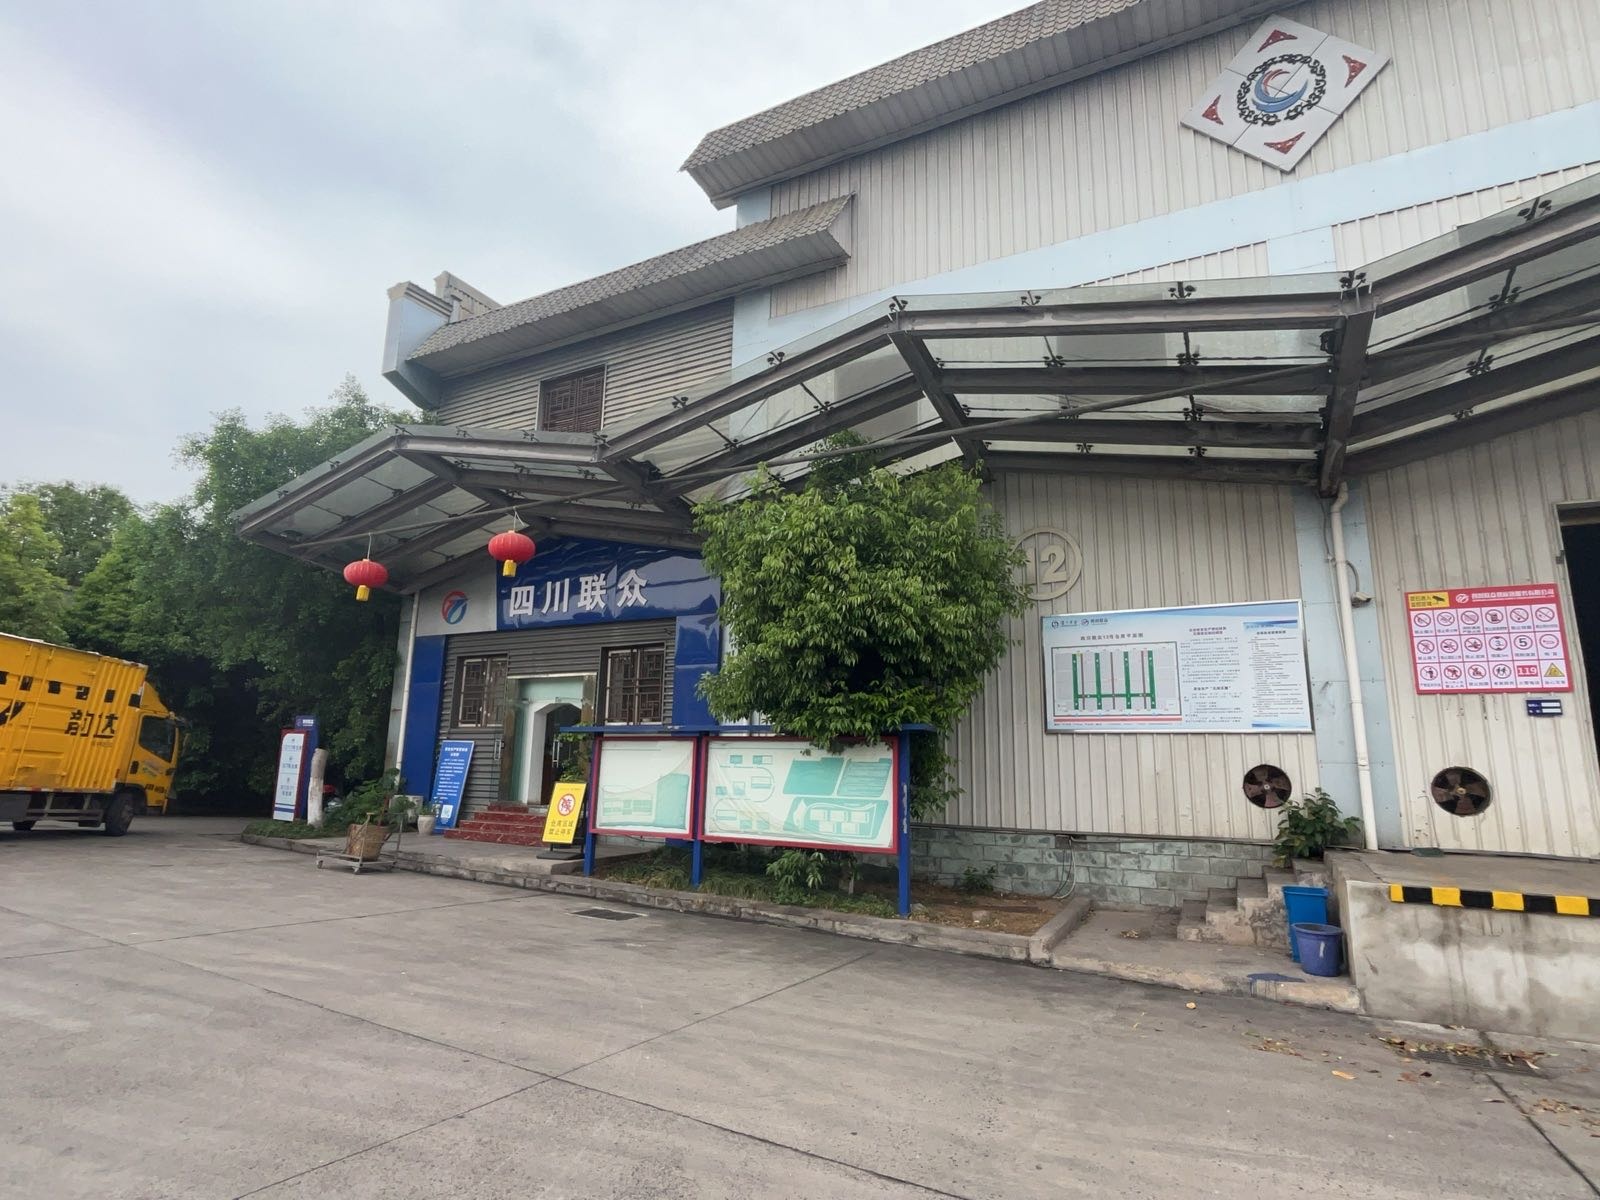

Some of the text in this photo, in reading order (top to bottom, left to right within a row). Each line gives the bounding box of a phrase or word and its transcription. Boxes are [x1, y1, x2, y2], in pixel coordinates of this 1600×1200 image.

[1025, 544, 1067, 585] 12
[509, 569, 647, 617] 四川联众
[1519, 638, 1528, 647] 5
[1517, 667, 1537, 676] 119
